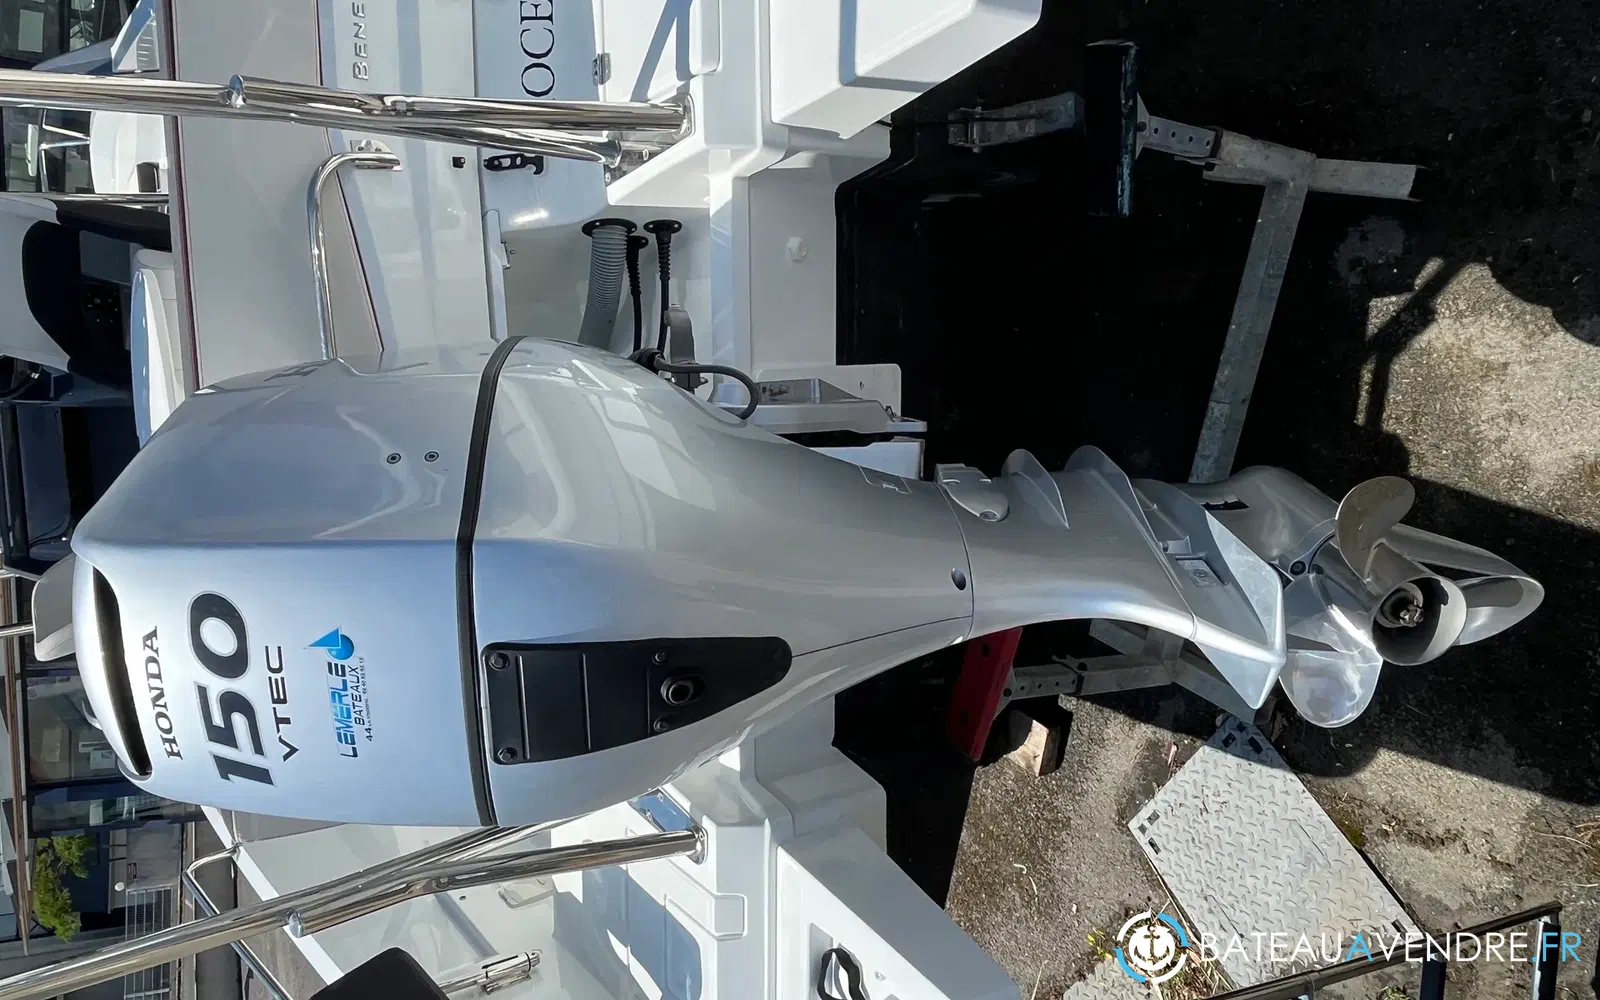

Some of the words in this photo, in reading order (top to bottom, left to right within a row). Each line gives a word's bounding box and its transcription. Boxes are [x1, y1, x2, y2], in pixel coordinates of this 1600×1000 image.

[352, 0, 368, 80] BENE
[520, 0, 555, 97] OCE
[143, 626, 183, 760] HONDA
[188, 591, 276, 787] 150
[265, 645, 300, 762] VTEC
[327, 661, 358, 758] LEMERLE
[348, 665, 365, 726] BATEAUX
[364, 727, 373, 742] 44
